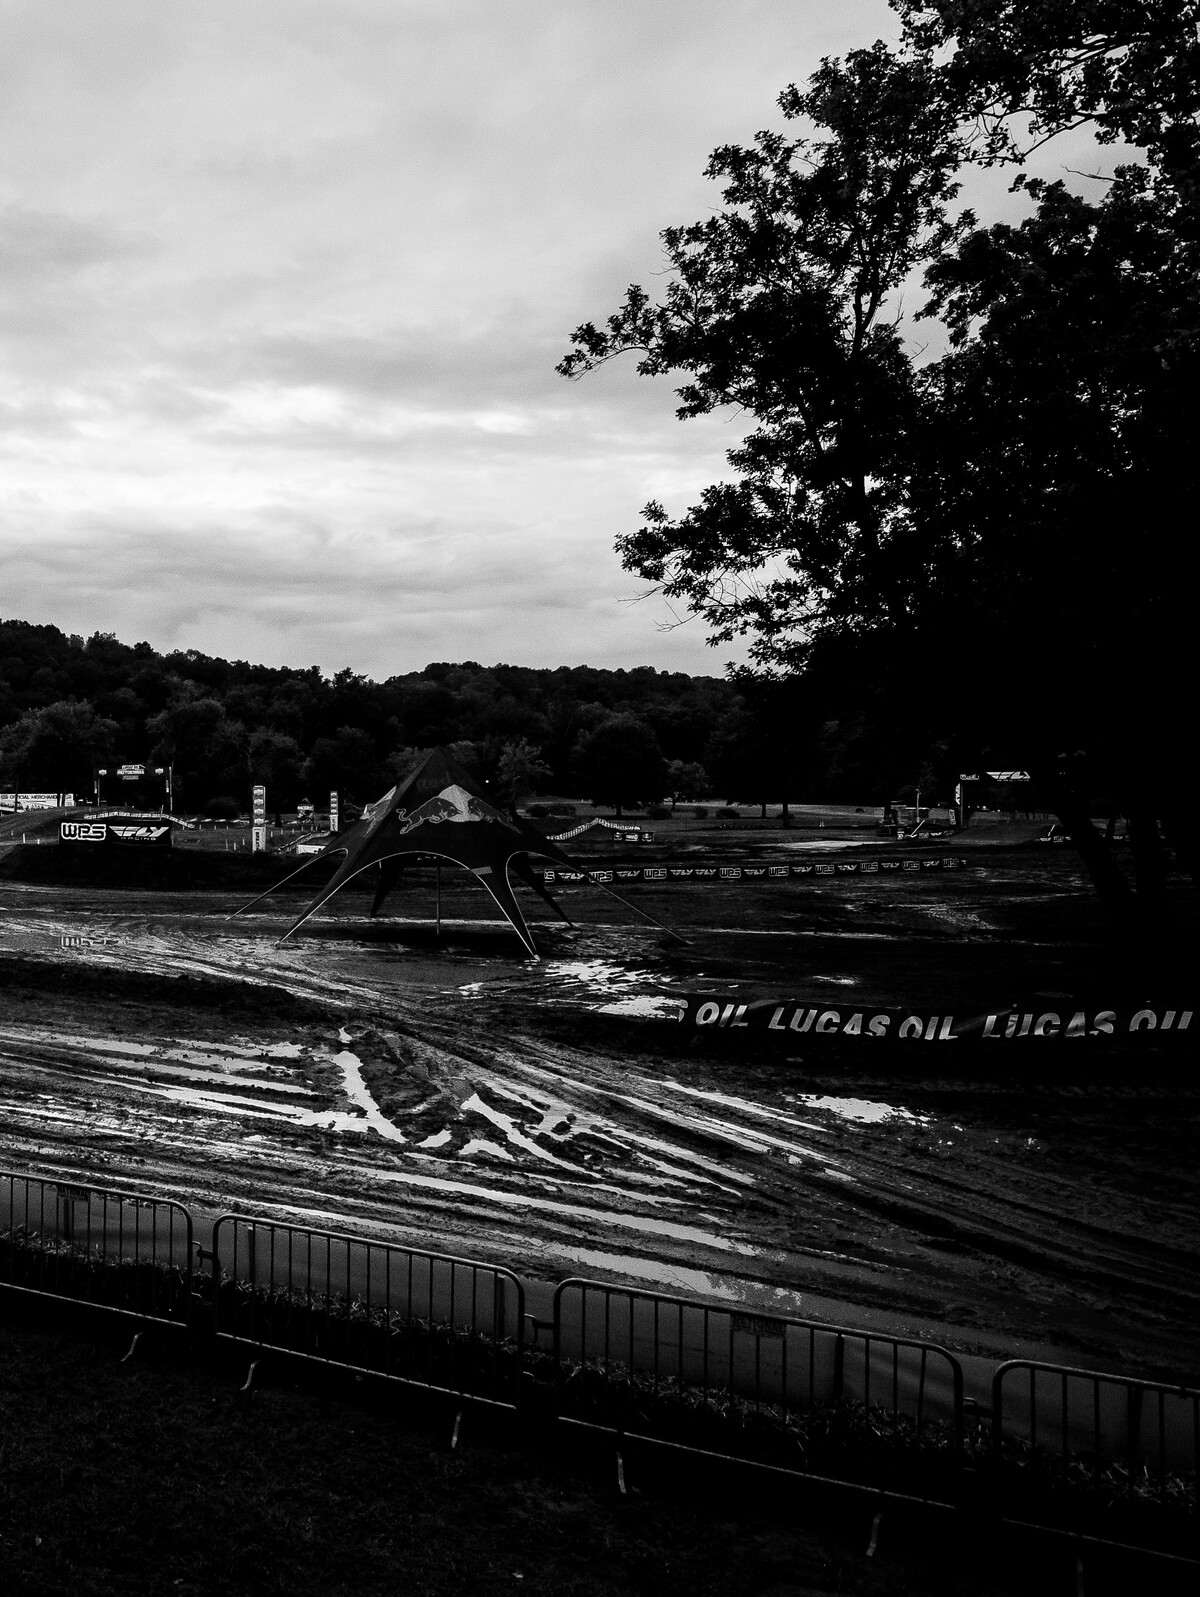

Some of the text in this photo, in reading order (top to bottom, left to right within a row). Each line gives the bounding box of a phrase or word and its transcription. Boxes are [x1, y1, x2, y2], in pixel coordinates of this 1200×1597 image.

[61, 823, 106, 841] WPS
[108, 826, 169, 837] FLY
[695, 1002, 749, 1028] OIL
[768, 1007, 891, 1037] LUCAS
[899, 1015, 959, 1040] OIL
